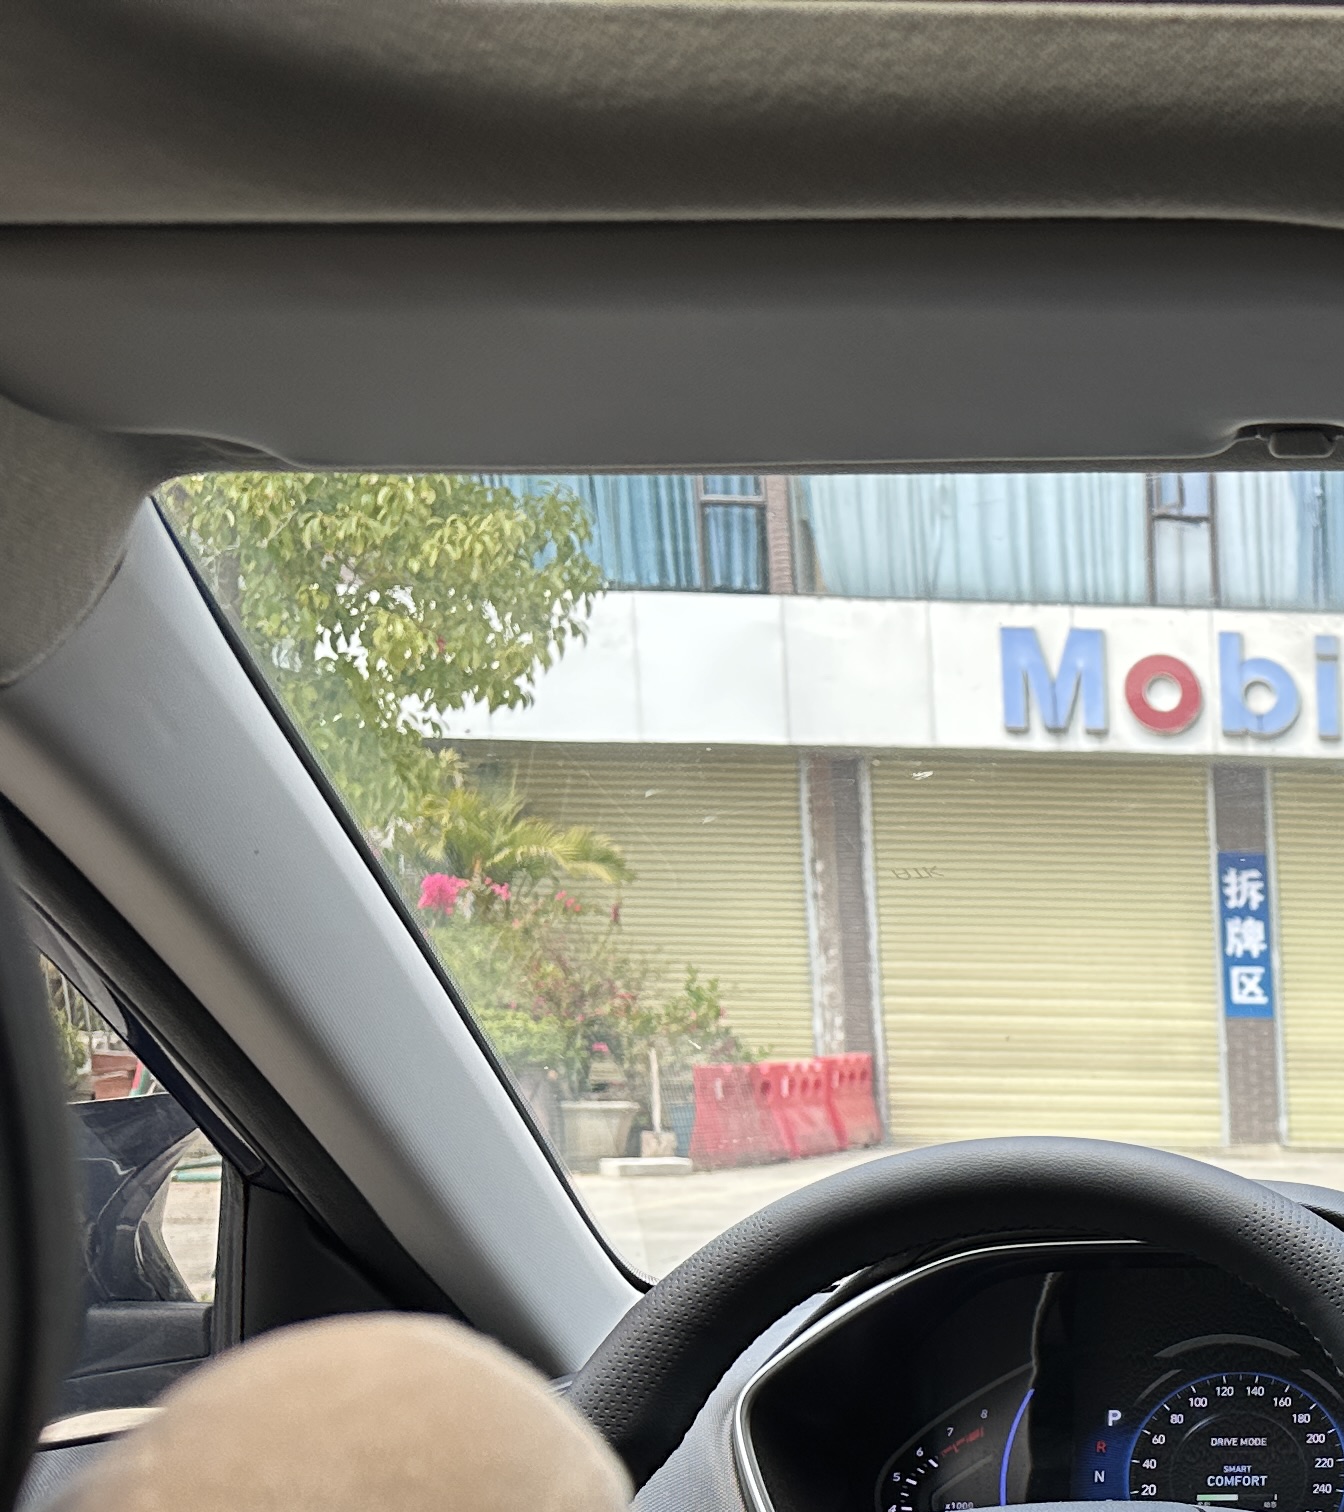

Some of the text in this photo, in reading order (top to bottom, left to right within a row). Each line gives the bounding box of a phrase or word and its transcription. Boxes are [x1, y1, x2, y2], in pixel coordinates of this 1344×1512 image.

[1221, 866, 1269, 1005] 拆牌区
[1215, 1386, 1234, 1397] 120
[1246, 1386, 1265, 1397] 140
[1189, 1397, 1208, 1408] 100
[1273, 1397, 1292, 1407] 160
[979, 1409, 988, 1419] 8
[1107, 1409, 1122, 1427] P
[1170, 1413, 1184, 1424] 80
[1292, 1413, 1311, 1424] 180
[946, 1426, 954, 1436] 7
[1151, 1434, 1166, 1445] 60
[1210, 1437, 1268, 1447] DRIVE MODE
[1305, 1433, 1326, 1444] 200
[916, 1447, 924, 1457] 6
[1096, 1440, 1107, 1453] R
[1142, 1458, 1157, 1469] 40
[1223, 1465, 1252, 1473] SMART
[1314, 1458, 1334, 1469] 220
[892, 1471, 901, 1482] 5
[1094, 1470, 1105, 1483] N
[1206, 1475, 1268, 1487] COMFORT
[1141, 1484, 1157, 1496] 20
[1312, 1483, 1332, 1494] 240
